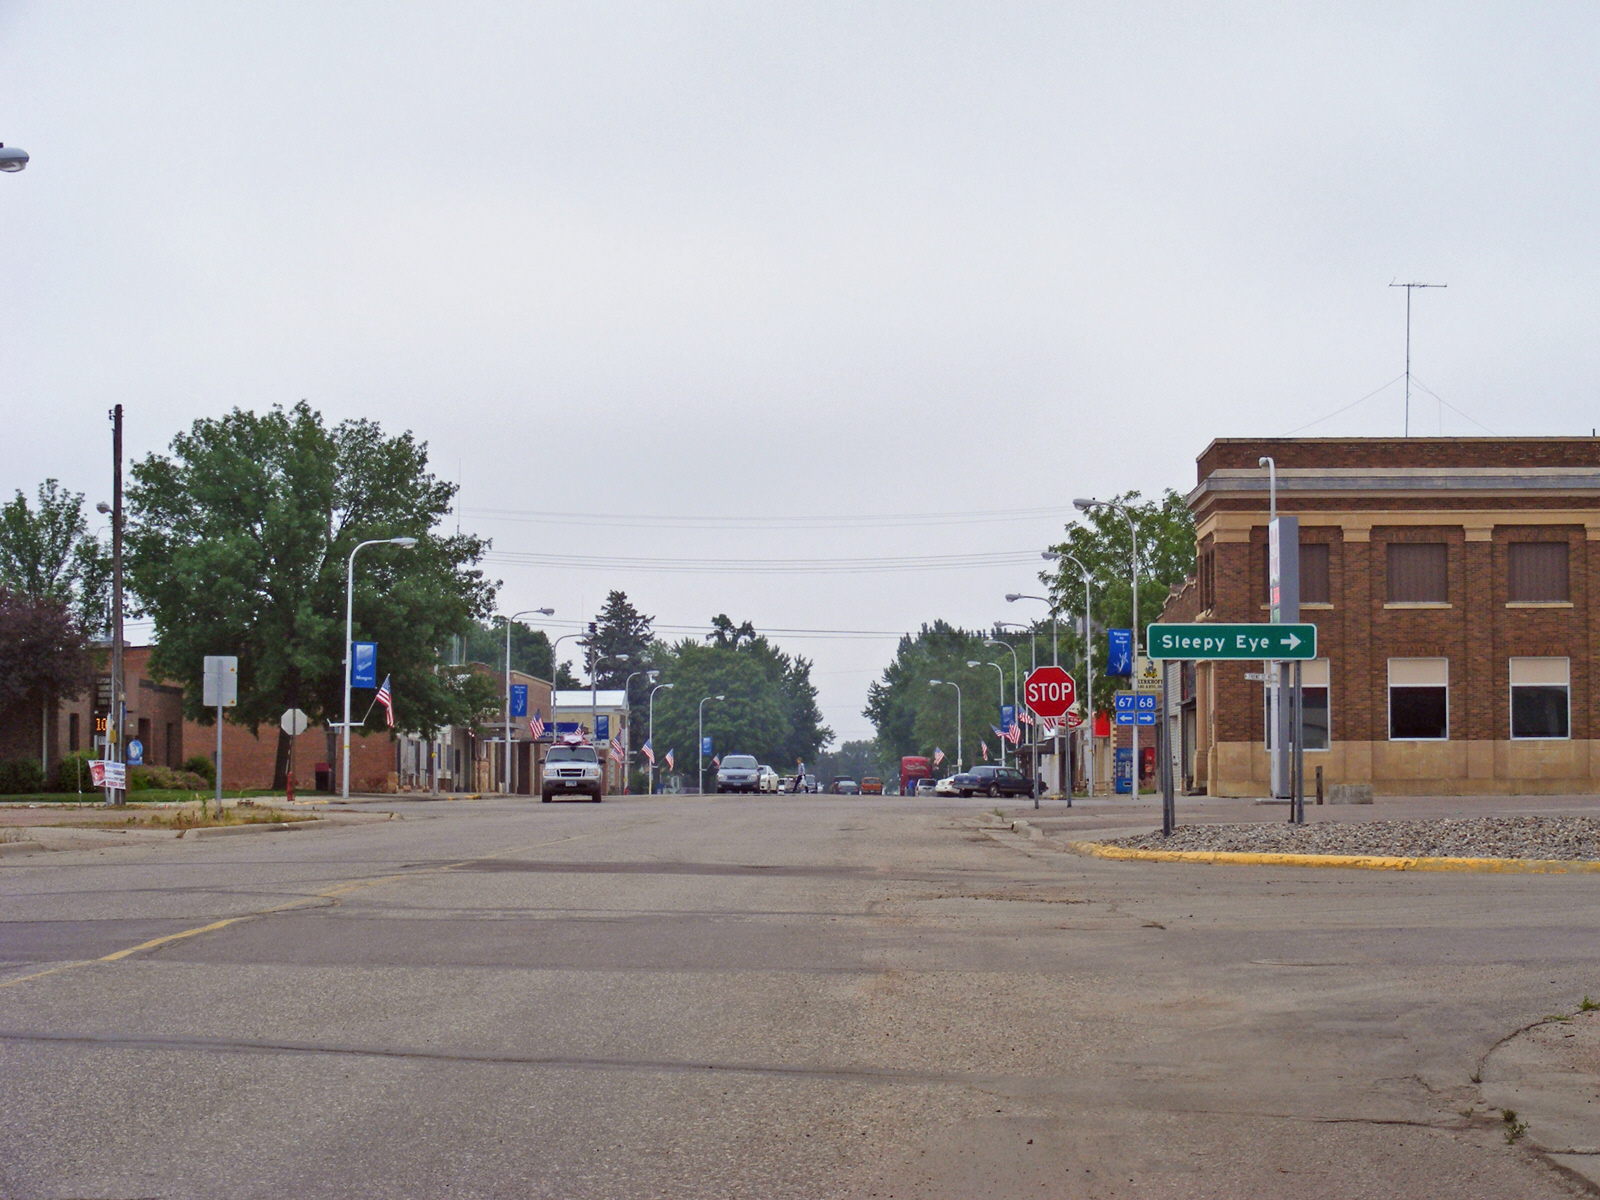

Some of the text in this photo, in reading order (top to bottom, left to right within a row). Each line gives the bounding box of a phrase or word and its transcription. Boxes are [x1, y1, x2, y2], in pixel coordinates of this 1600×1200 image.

[1162, 634, 1270, 652] Sleepy Eye
[1028, 682, 1072, 702] STOP
[1118, 697, 1132, 708] 67
[1139, 697, 1154, 708] 68
